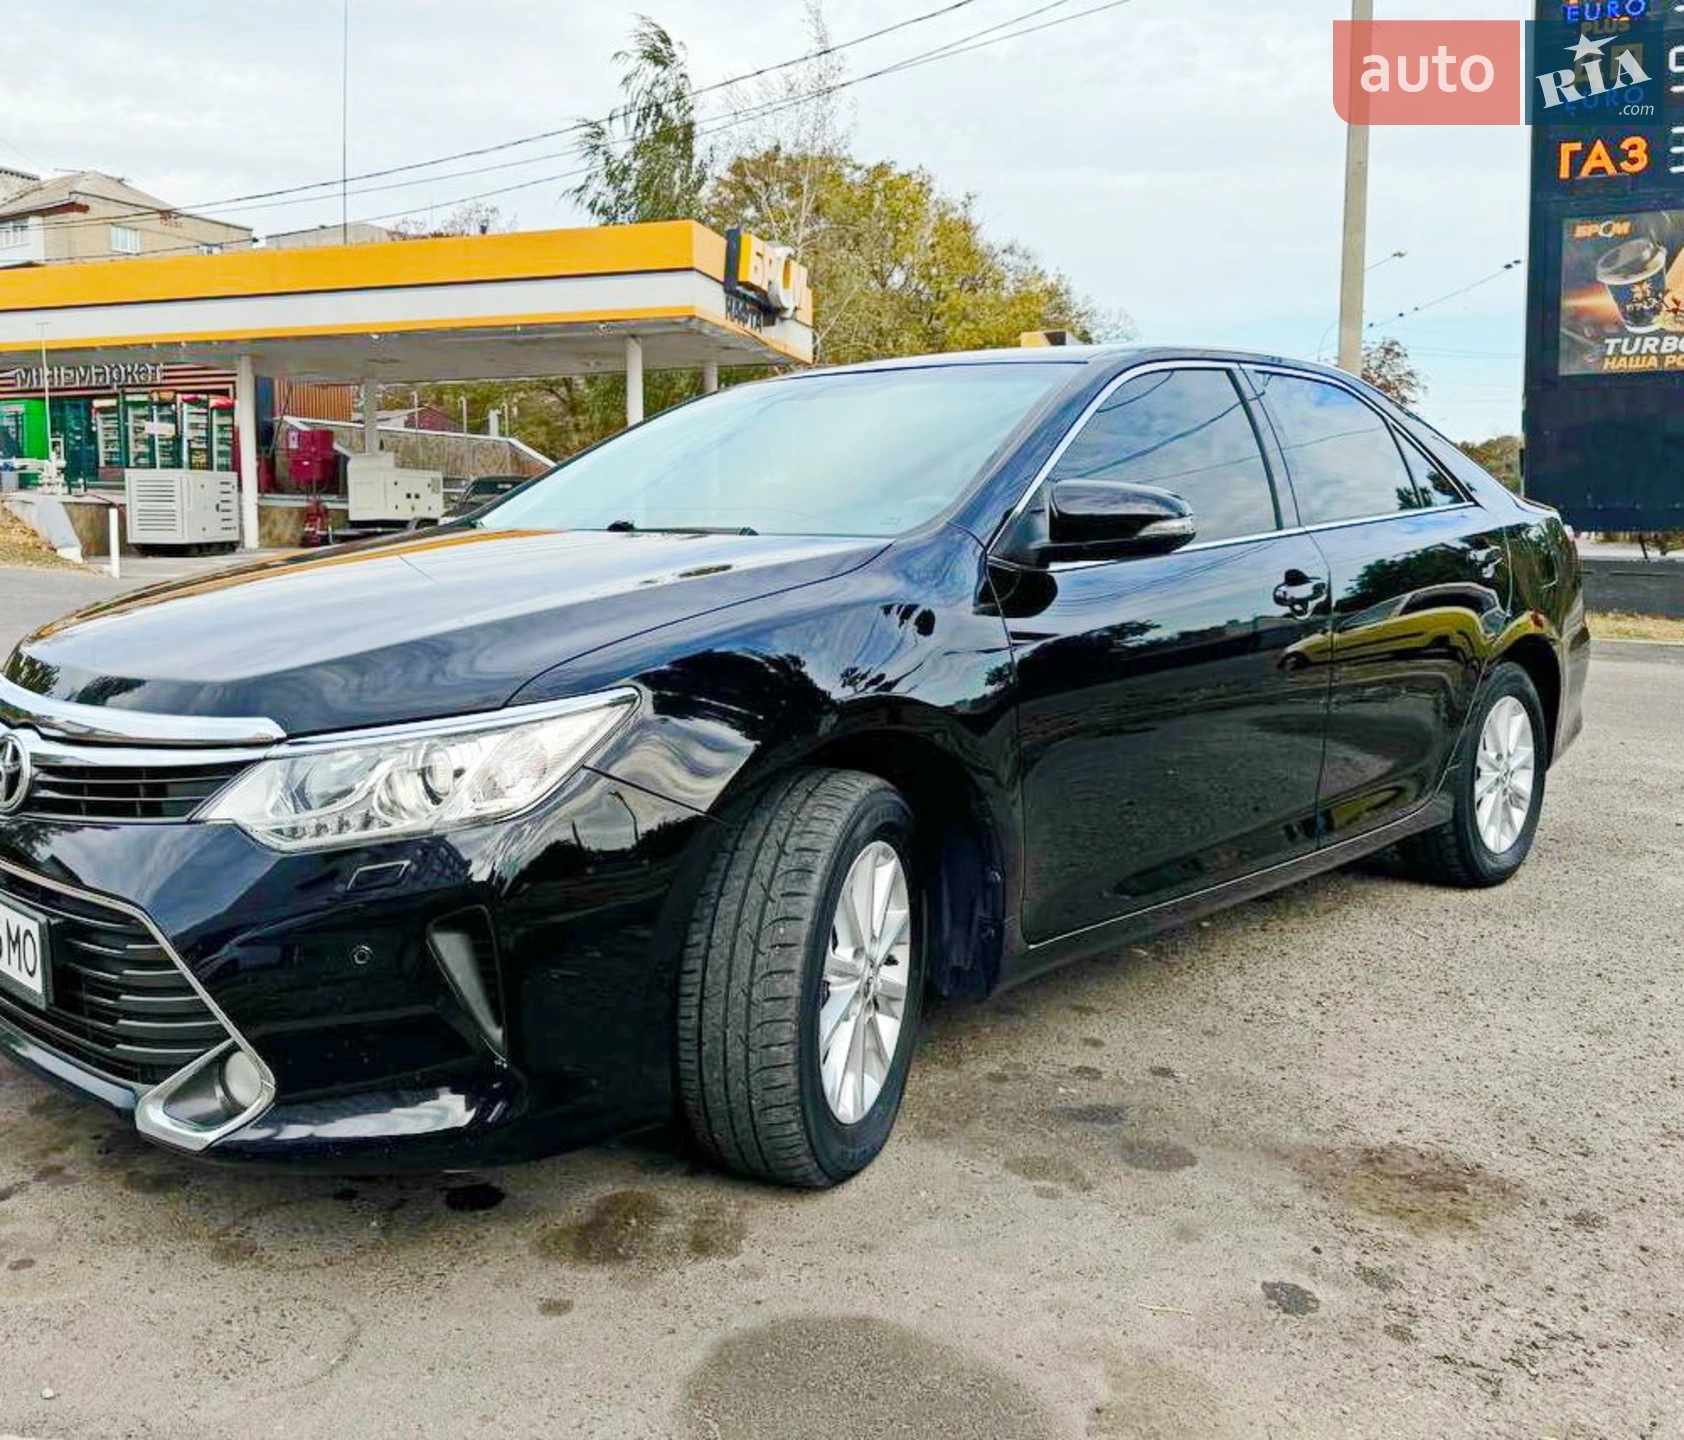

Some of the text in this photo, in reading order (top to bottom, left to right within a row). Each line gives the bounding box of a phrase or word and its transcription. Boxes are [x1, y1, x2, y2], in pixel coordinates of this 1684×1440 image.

[1566, 0, 1646, 21] EURO
[1558, 136, 1648, 179] ГАЗ
[1603, 356, 1658, 371] НАША
